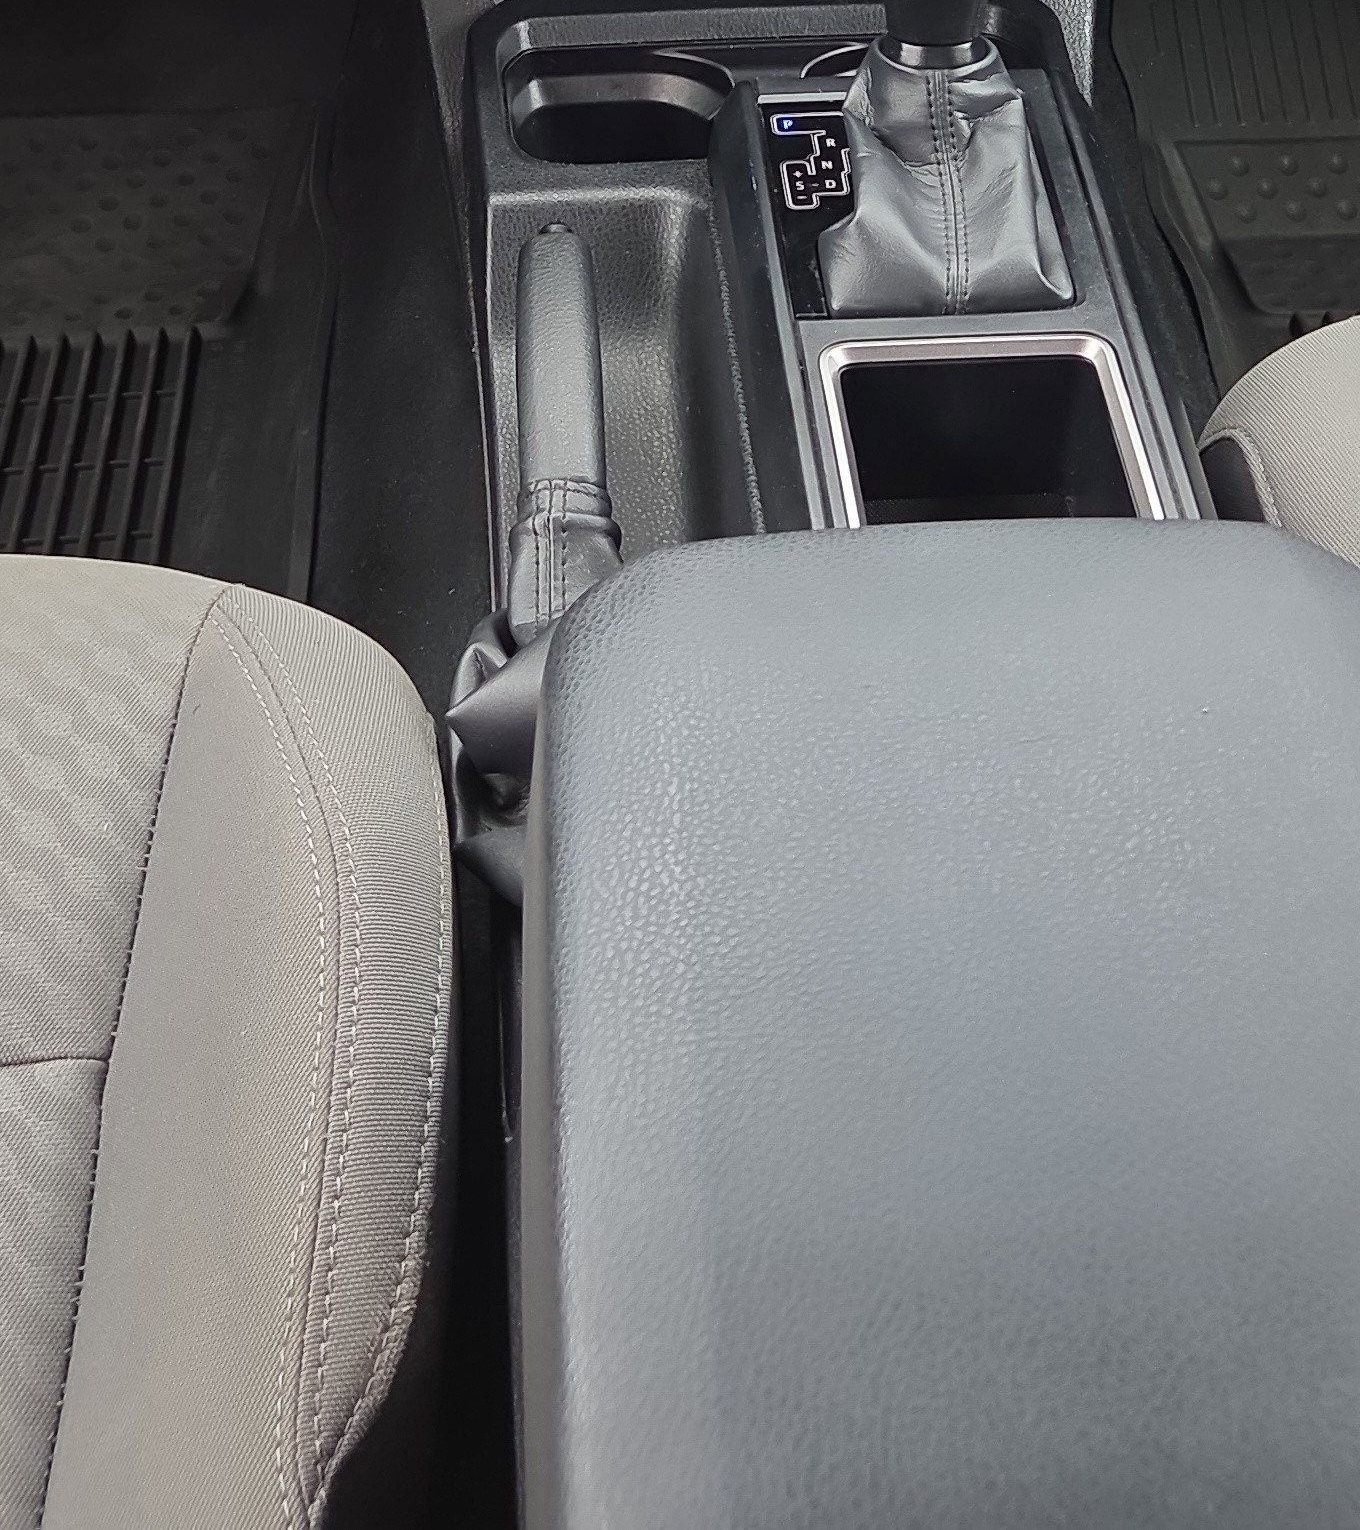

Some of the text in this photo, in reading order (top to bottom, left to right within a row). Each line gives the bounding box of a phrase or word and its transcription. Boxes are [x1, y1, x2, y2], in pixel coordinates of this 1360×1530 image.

[782, 119, 794, 130] P
[825, 138, 837, 147] R
[821, 159, 834, 170] N
[795, 180, 805, 190] S
[825, 178, 837, 189] D
